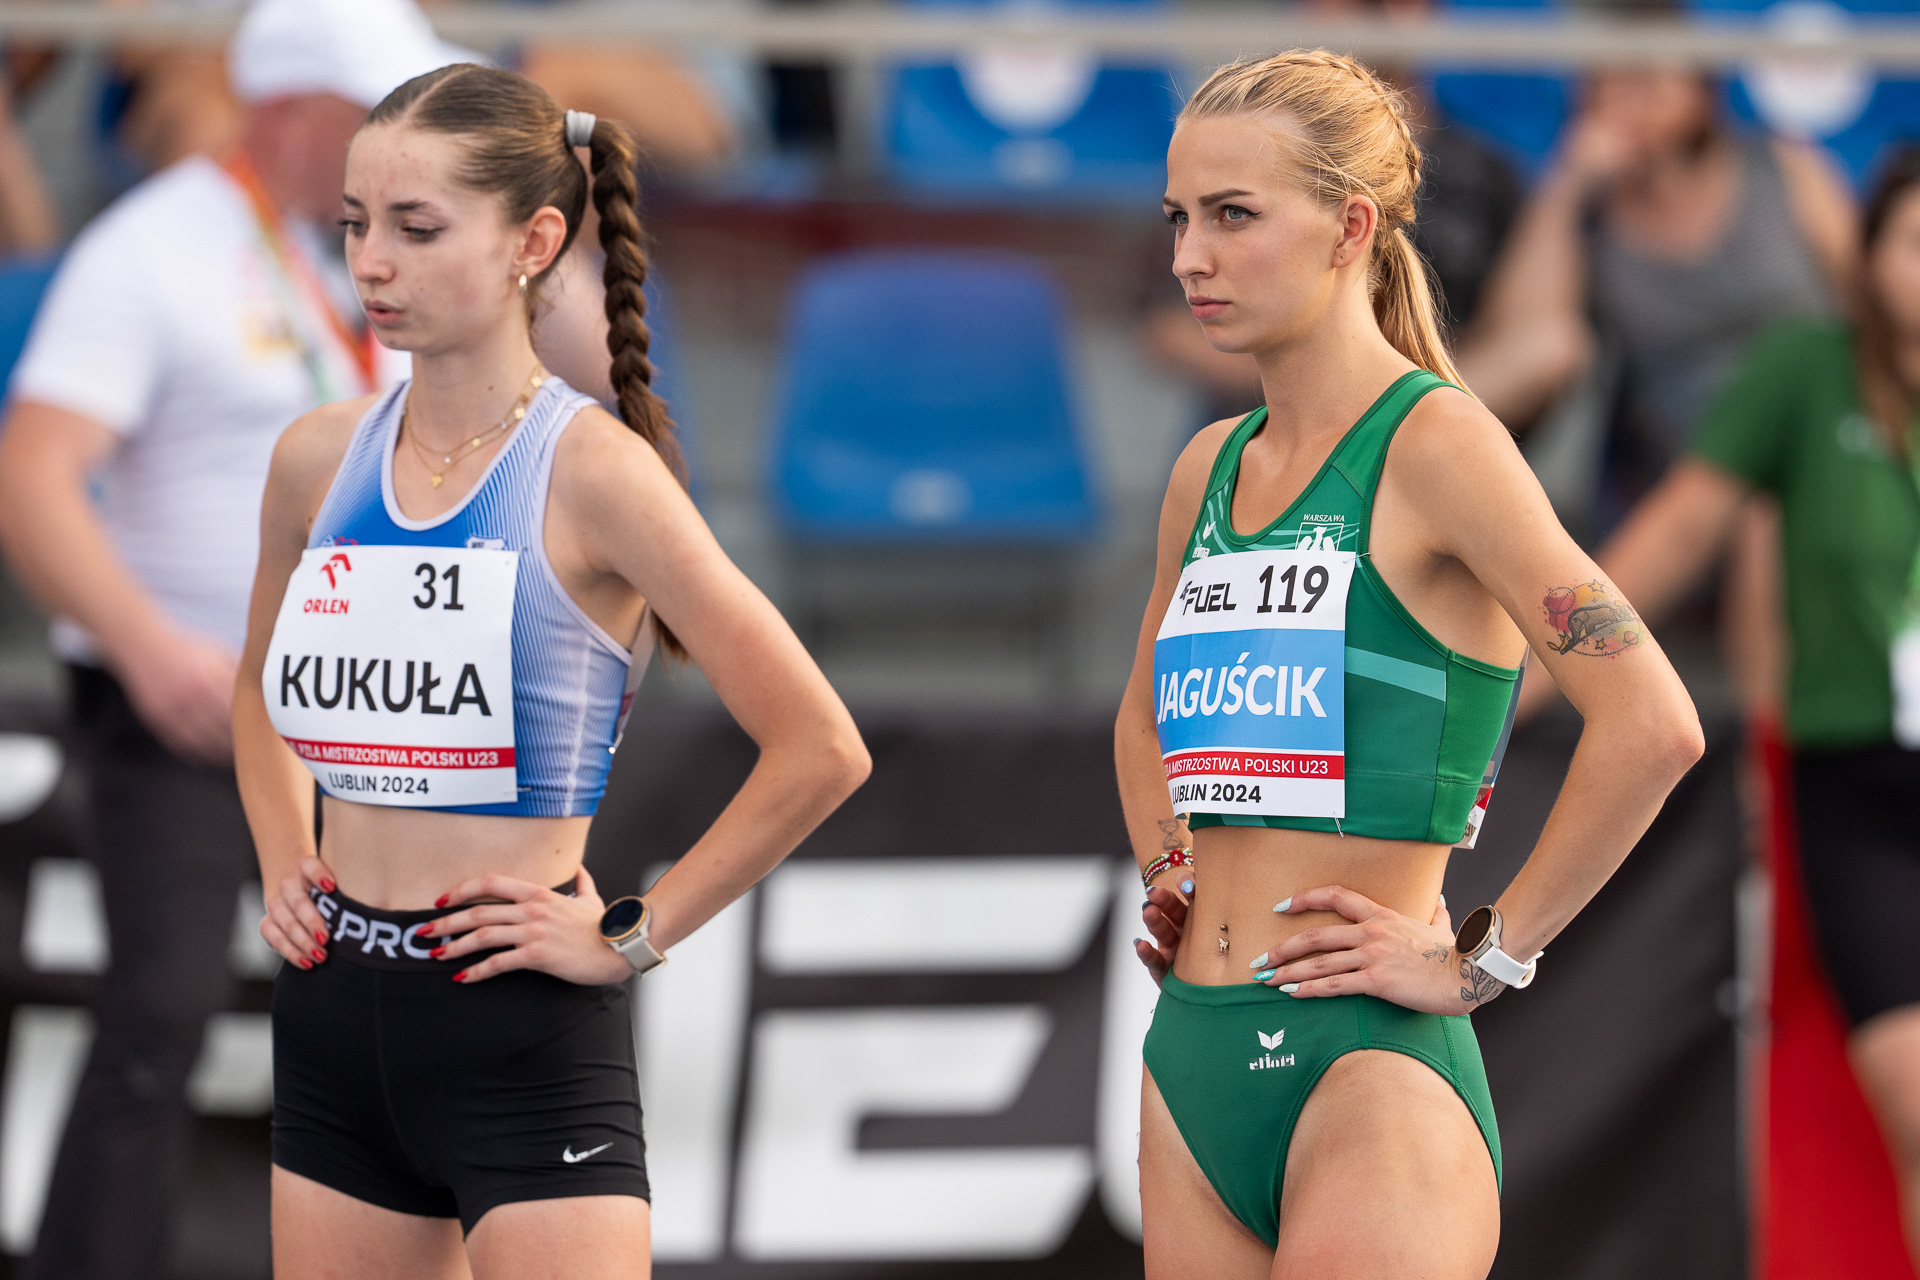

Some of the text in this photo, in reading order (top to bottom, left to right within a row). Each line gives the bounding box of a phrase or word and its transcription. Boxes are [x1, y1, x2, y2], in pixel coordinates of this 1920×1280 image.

[1303, 513, 1345, 522] WARSZAWA
[413, 562, 464, 611] 31
[1256, 565, 1330, 614] 119
[303, 599, 350, 614] ORLEN
[280, 654, 493, 717] KUKUŁA
[1157, 651, 1328, 725] JAGUŚCIK
[321, 745, 409, 765] MISTRZOSTWA
[411, 750, 464, 767] POLSKI
[467, 751, 499, 767] U23
[1171, 757, 1241, 775] MISTRZOSTWA
[1244, 758, 1295, 774] POLSKI
[1299, 760, 1328, 775] U23
[328, 771, 429, 794] LUBLIN 2024
[1172, 782, 1262, 805] LUBLIN 2024
